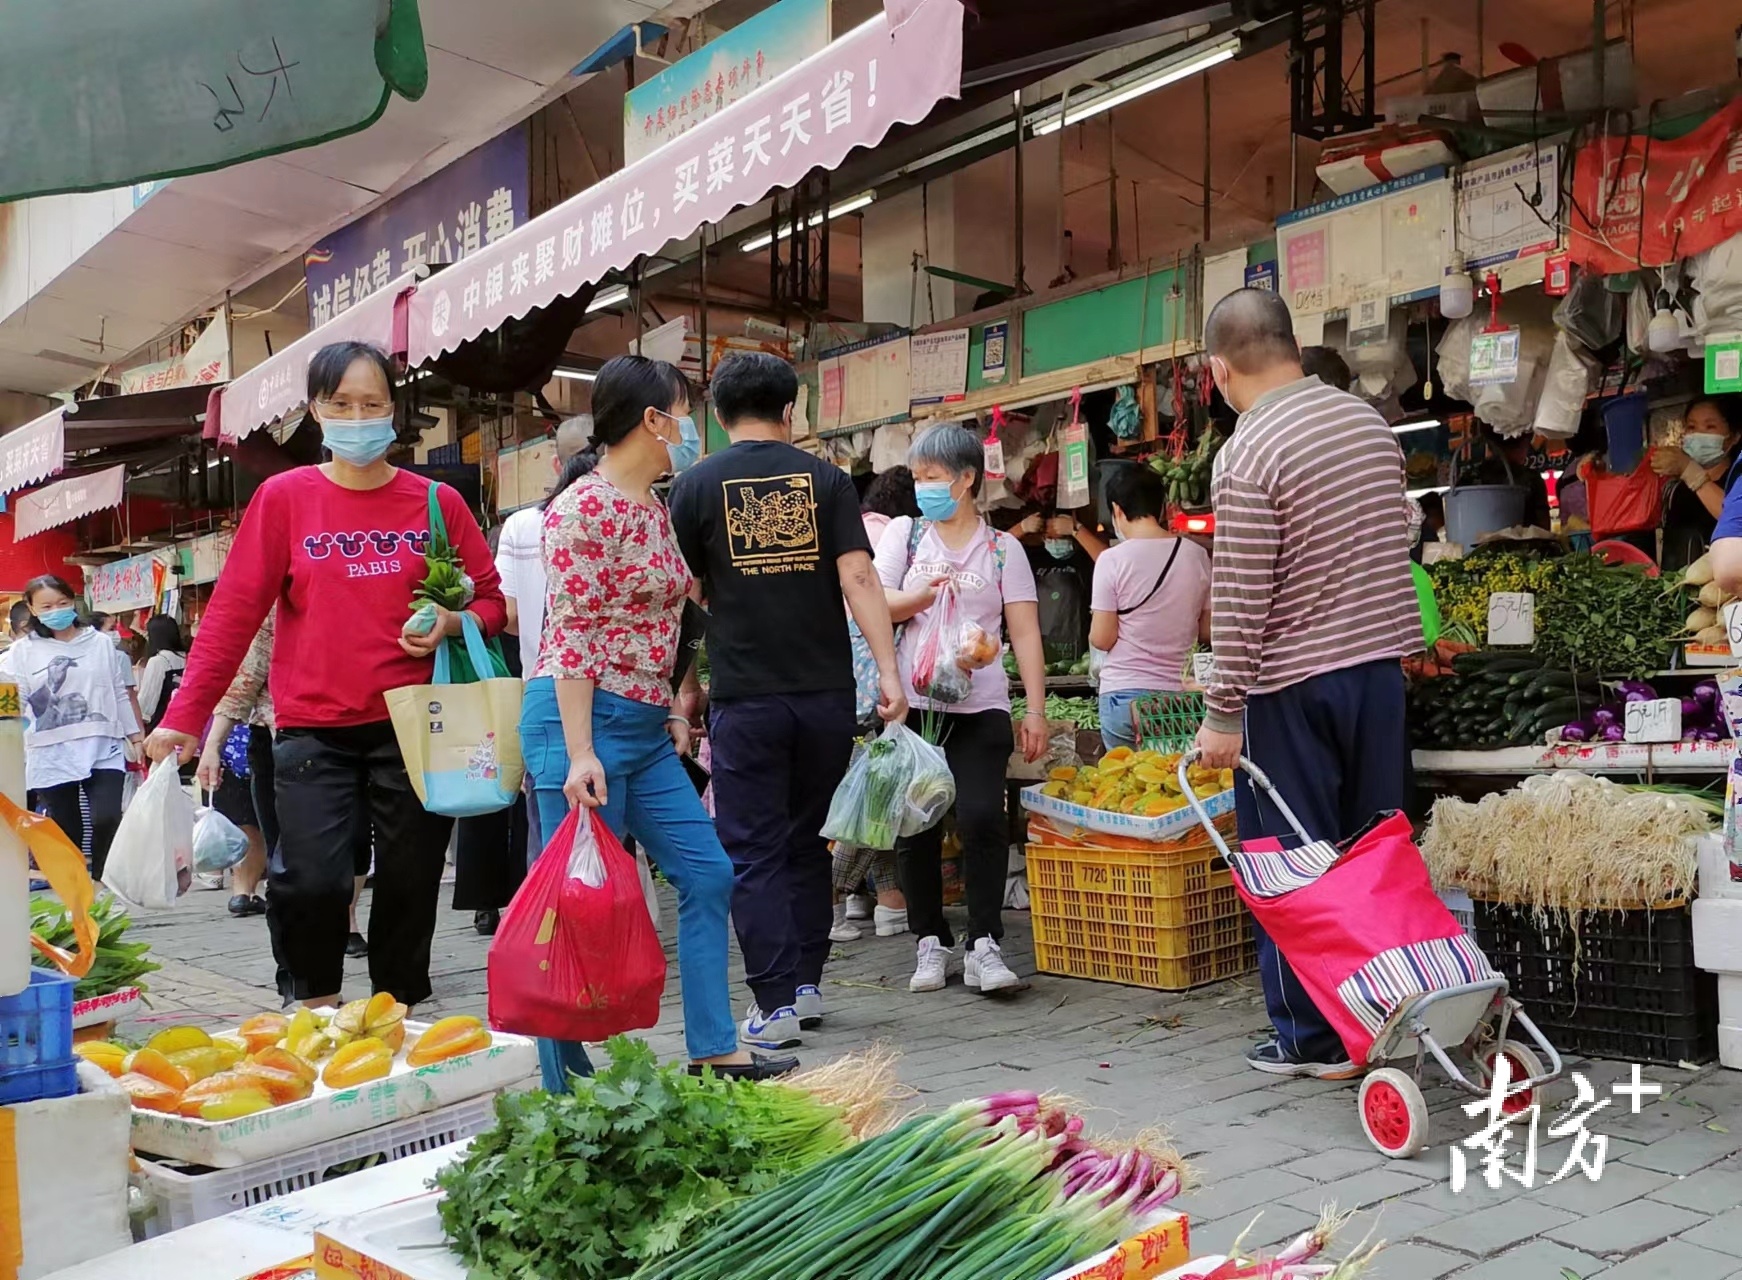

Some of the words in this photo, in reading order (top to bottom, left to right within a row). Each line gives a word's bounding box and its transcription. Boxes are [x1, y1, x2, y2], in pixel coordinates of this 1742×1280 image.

[740, 567, 760, 576] THE
[761, 564, 792, 575] NORTH
[793, 562, 815, 572] FACE
